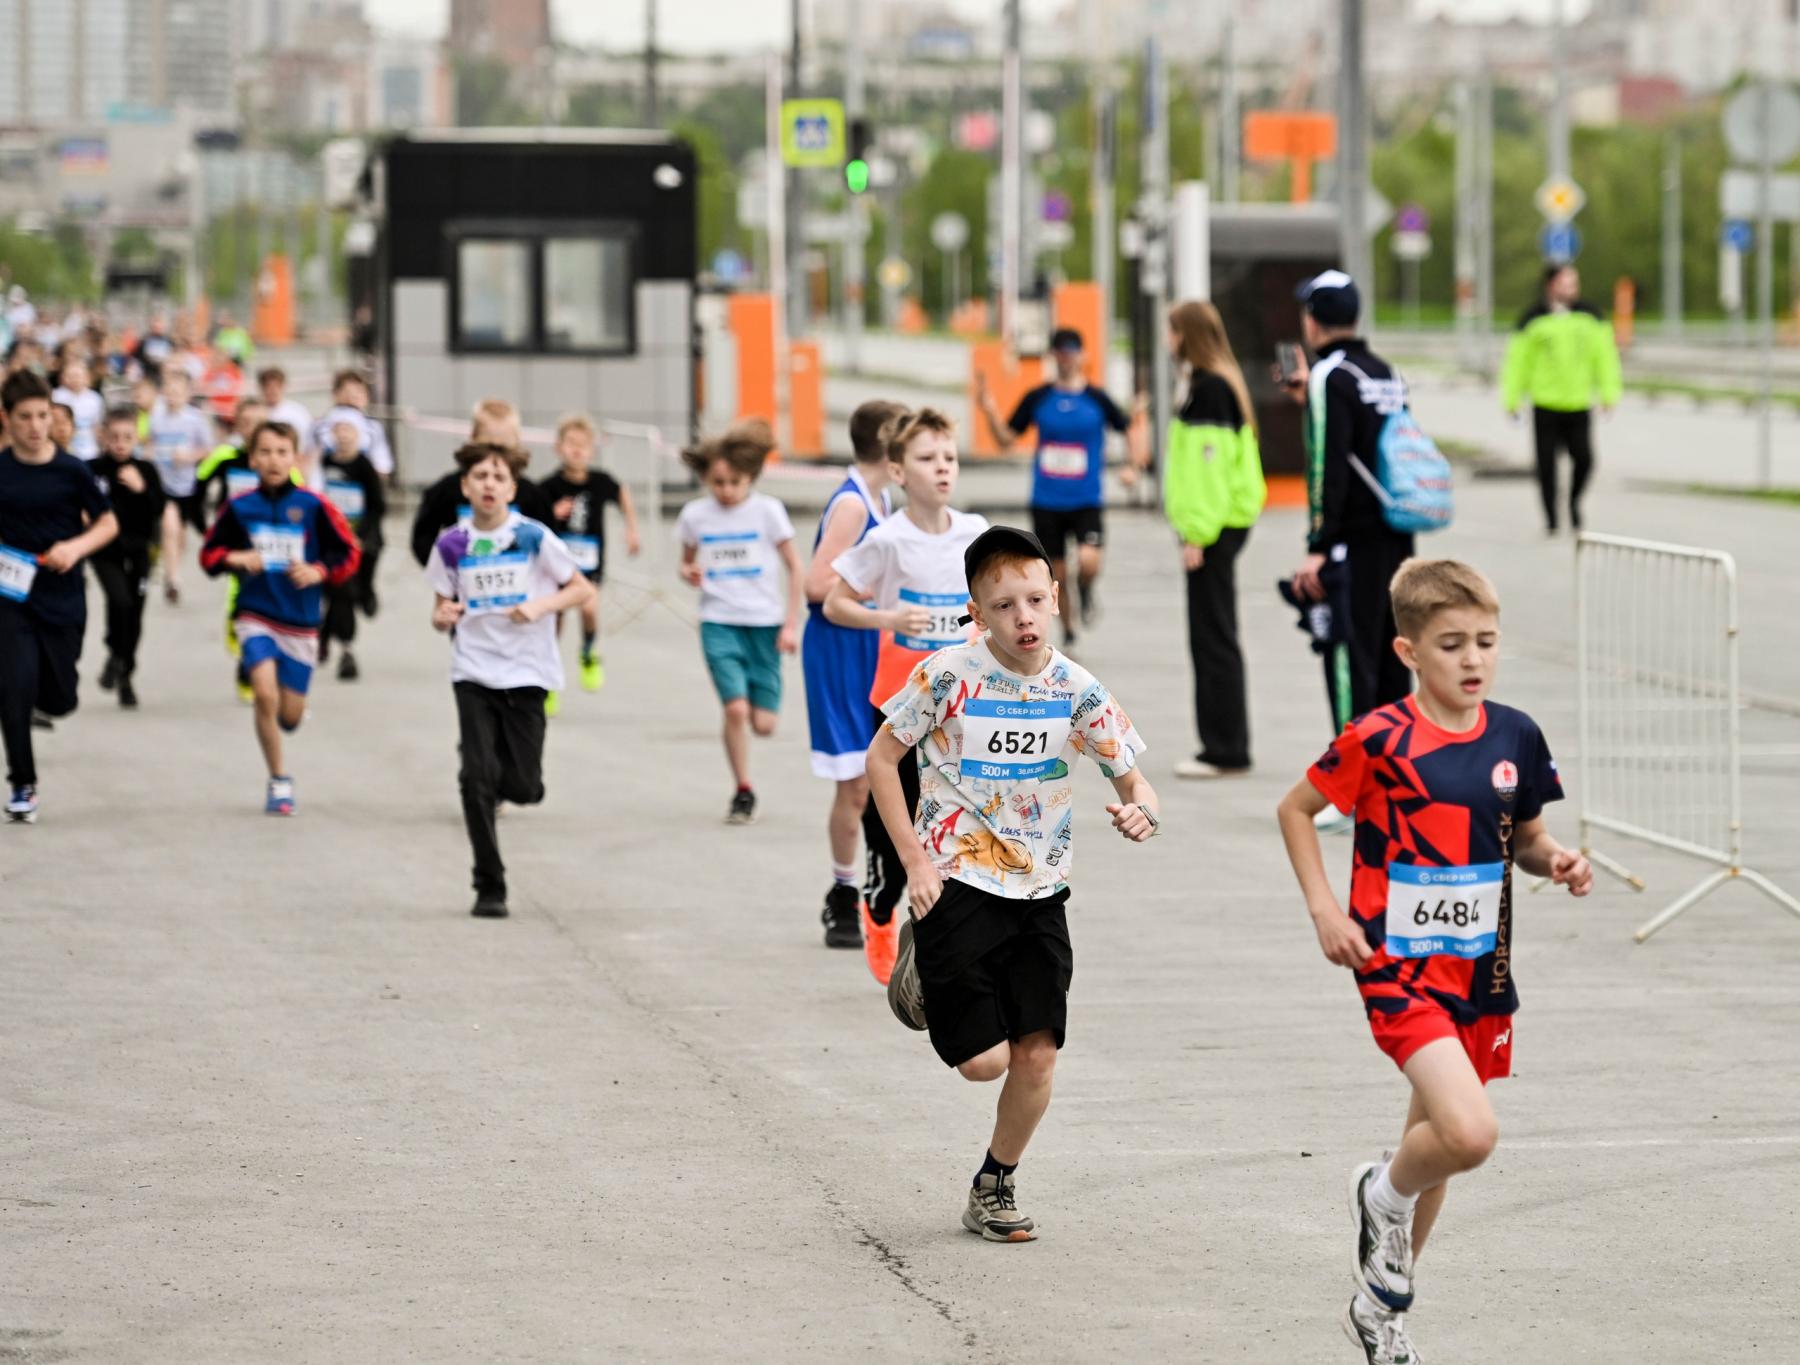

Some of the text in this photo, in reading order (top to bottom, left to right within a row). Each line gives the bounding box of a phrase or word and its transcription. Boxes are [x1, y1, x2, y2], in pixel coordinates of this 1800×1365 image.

[926, 615, 959, 634] 515
[1029, 708, 1046, 716] KIDS
[987, 730, 1048, 755] 6521
[981, 764, 1001, 777] 500
[1413, 899, 1481, 928] 6484
[1408, 940, 1432, 953] 500
